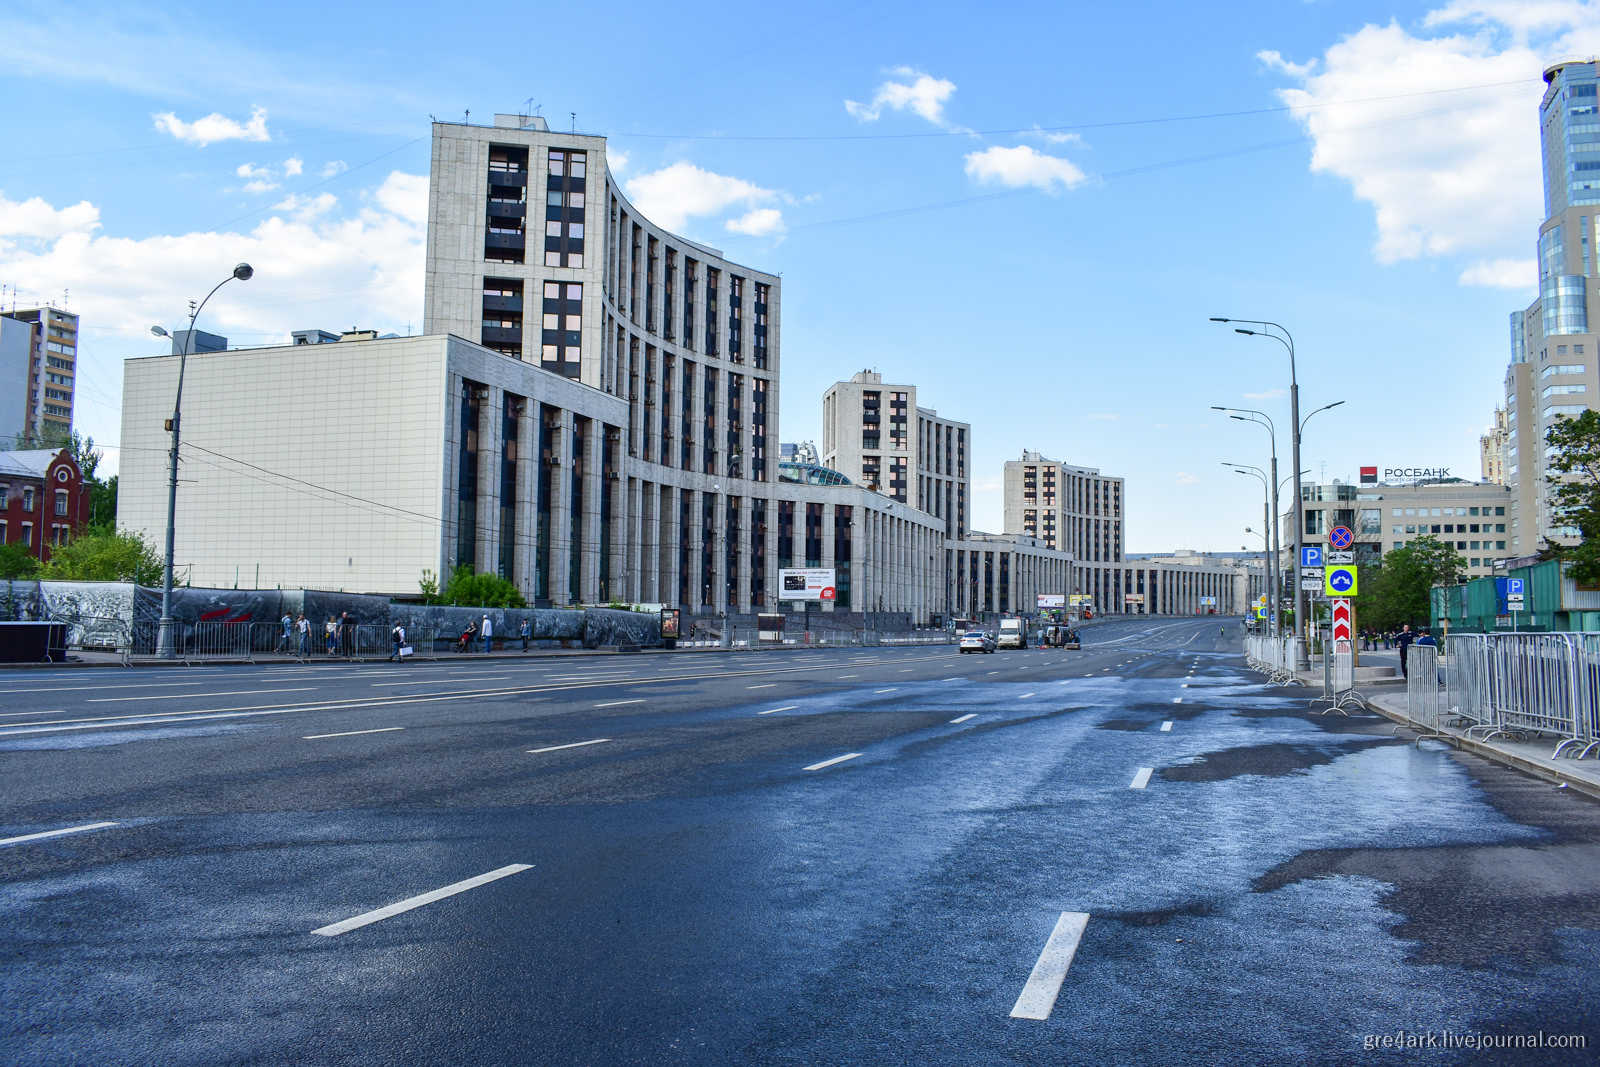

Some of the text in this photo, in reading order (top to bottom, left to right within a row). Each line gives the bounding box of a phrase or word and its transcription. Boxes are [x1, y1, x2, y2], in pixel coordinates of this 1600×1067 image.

[1385, 468, 1450, 477] РОСБАНК
[1307, 549, 1318, 565] P
[1512, 580, 1521, 592] P
